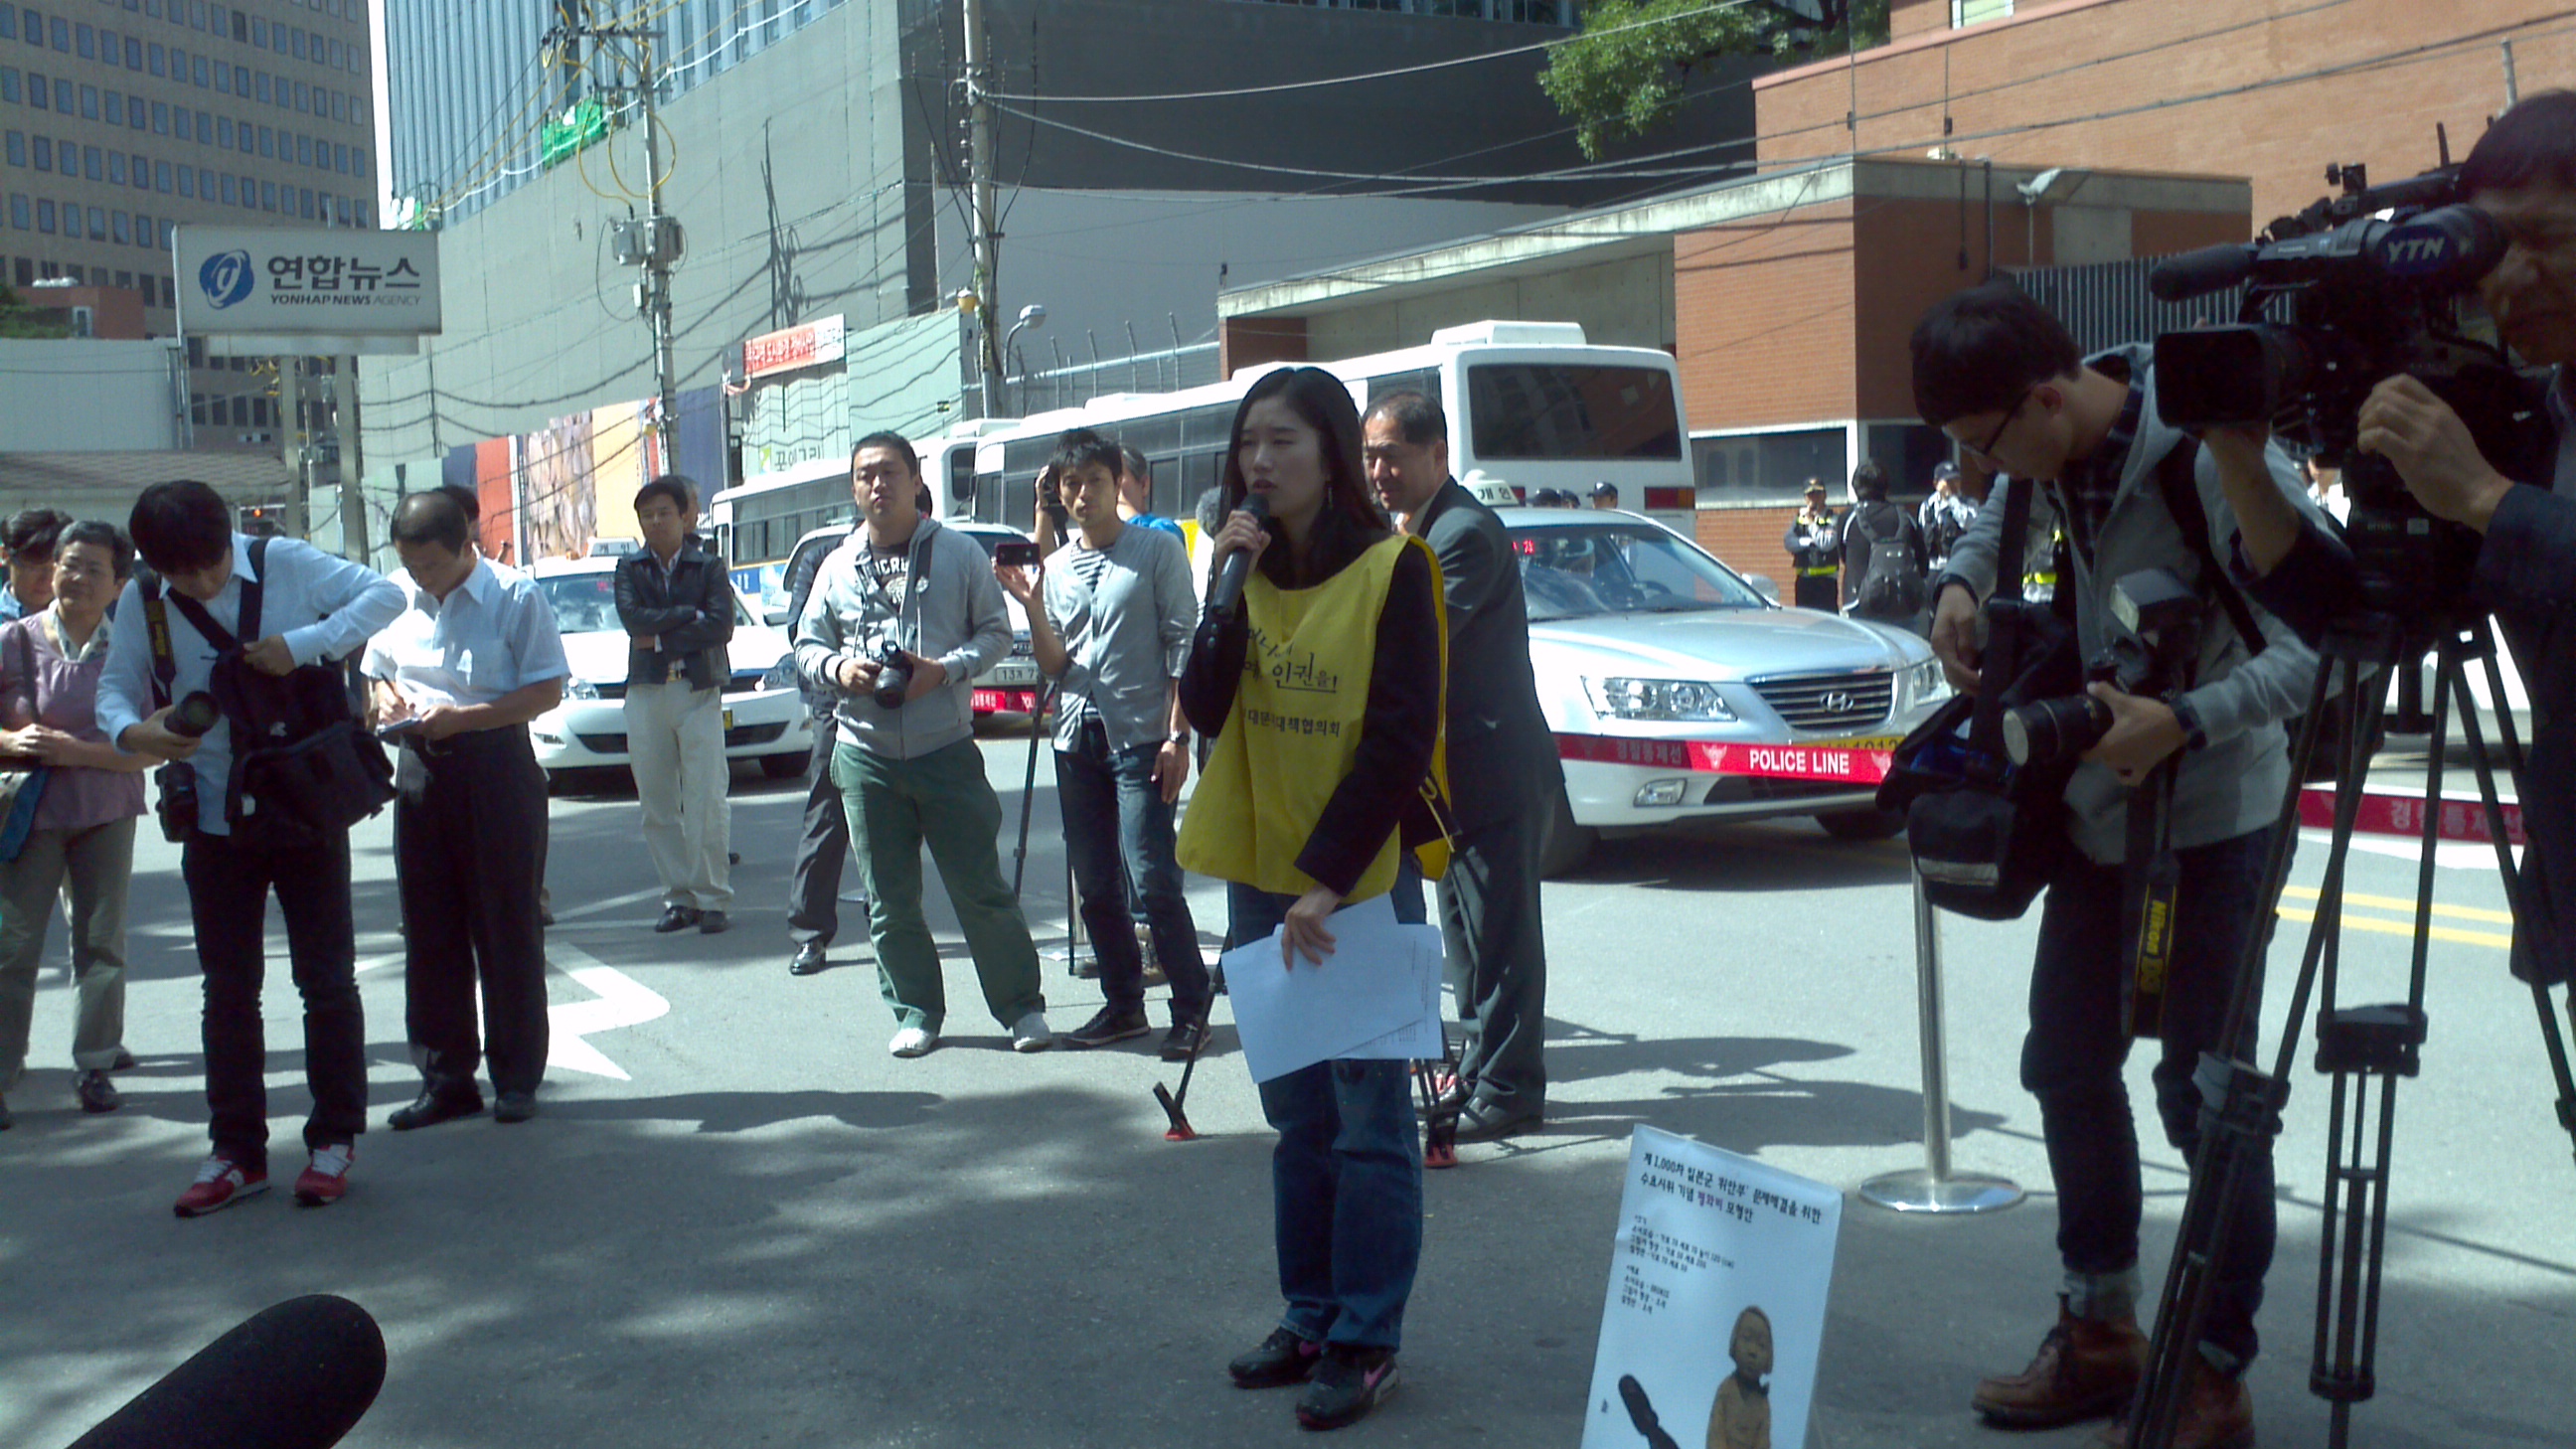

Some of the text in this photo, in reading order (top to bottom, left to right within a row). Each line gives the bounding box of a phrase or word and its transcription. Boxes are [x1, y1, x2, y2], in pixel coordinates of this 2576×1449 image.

[2388, 238, 2445, 262] YTN
[267, 255, 420, 291] 연합뉴스
[270, 294, 421, 306] YONHAP NEWS AGENCY
[1749, 748, 1851, 775] POLICE LINE
[1641, 1172, 1675, 1194] 수요시위
[1679, 1185, 1693, 1203] 기념
[1697, 1192, 1723, 1211] 평화비
[1643, 1152, 1652, 1166] 제
[1688, 1167, 1713, 1189] 일본군
[1802, 1205, 1822, 1224] 위한
